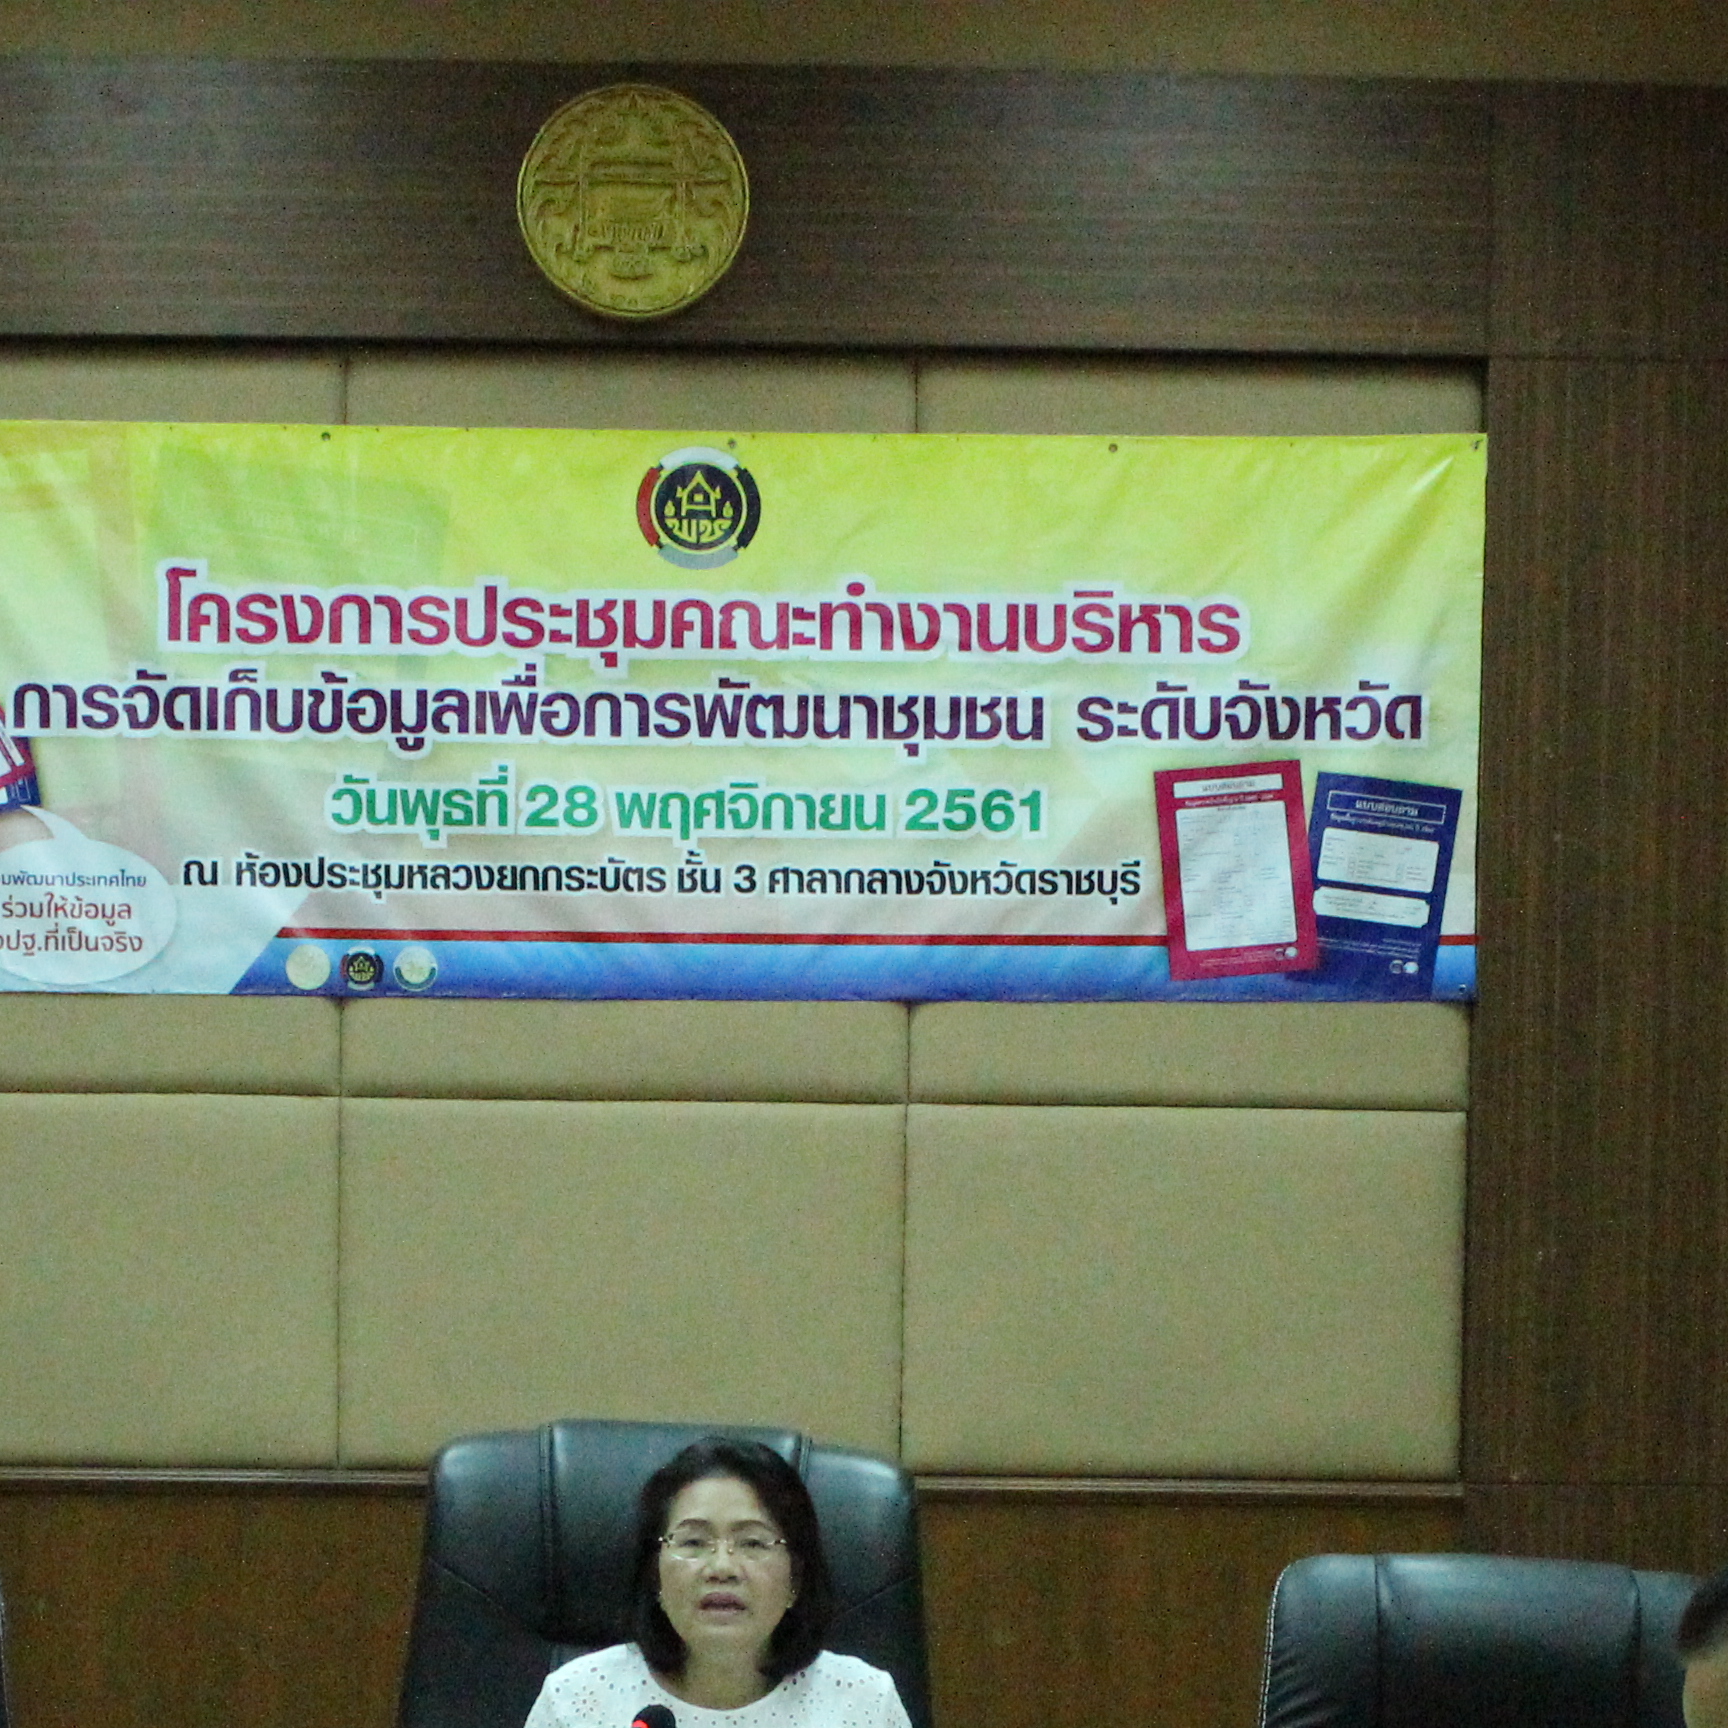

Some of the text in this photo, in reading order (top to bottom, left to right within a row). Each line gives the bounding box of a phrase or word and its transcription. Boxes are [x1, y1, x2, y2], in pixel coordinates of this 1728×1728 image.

[164, 567, 1242, 668] โครงการประชุมคณะทำงานบริหาร
[12, 663, 1423, 757] การจัดเก็บข้อมูลเพื่อการพัฒนาชุมชน ระดับจังหวัด
[331, 765, 1045, 840] วันพุธที่ 28 พฤศจิกายน 2561
[1, 892, 132, 926] ร่วมให้ข้อมูล
[182, 850, 1141, 904] ณ ห้องประชุมหลวงยกกระบัตร ชั้น 3 ศาลากลางจังหวัดราชบุรี
